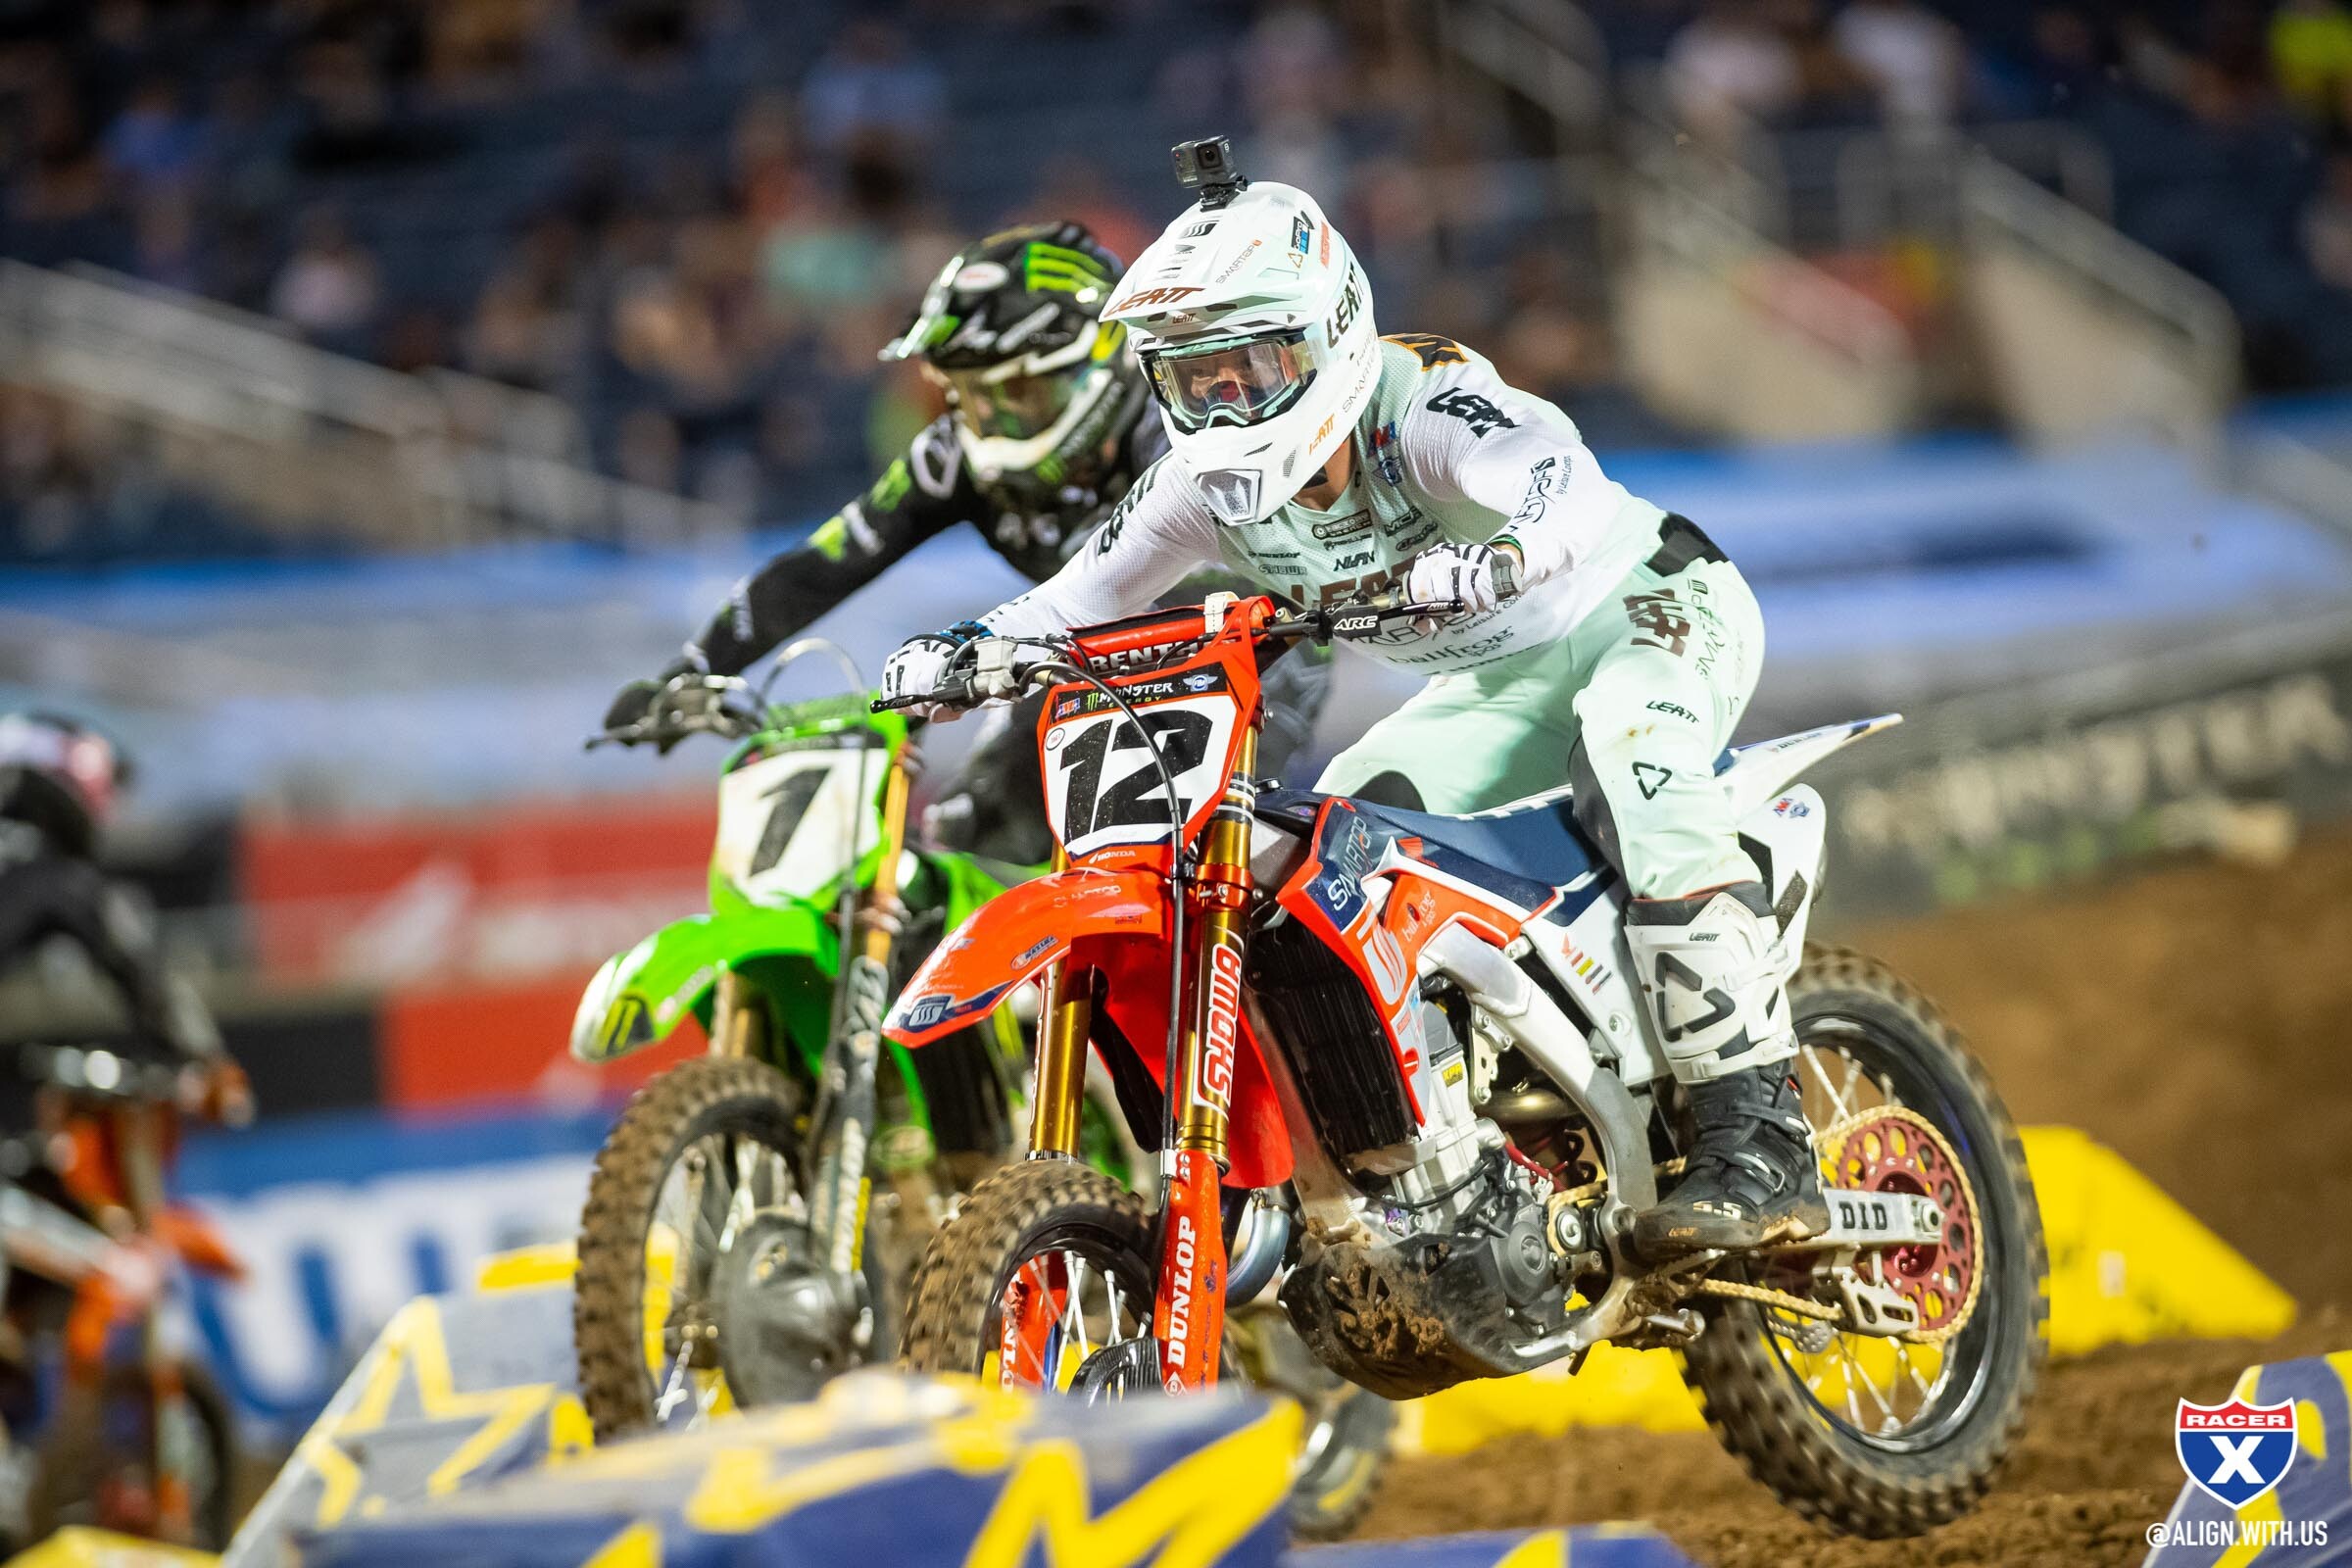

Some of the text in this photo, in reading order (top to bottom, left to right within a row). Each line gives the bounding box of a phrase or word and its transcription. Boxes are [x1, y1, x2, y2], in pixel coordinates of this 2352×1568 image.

[1103, 287, 1205, 318] LEATT
[1172, 314, 1196, 323] LEATT
[1334, 614, 1378, 630] ARC
[1465, 610, 1502, 629] Leisure
[1387, 625, 1514, 663] bullfrog
[1100, 683, 1174, 705] MNSTER
[1646, 700, 1699, 723] LEATT
[1060, 710, 1213, 847] 12
[750, 766, 835, 878] 1
[1098, 851, 1136, 861] HONDA
[1689, 933, 1721, 942] LEATT
[1200, 943, 1243, 1107] SHOWA
[1838, 1201, 1887, 1231] DID
[1168, 1215, 1197, 1368] DUNLOP
